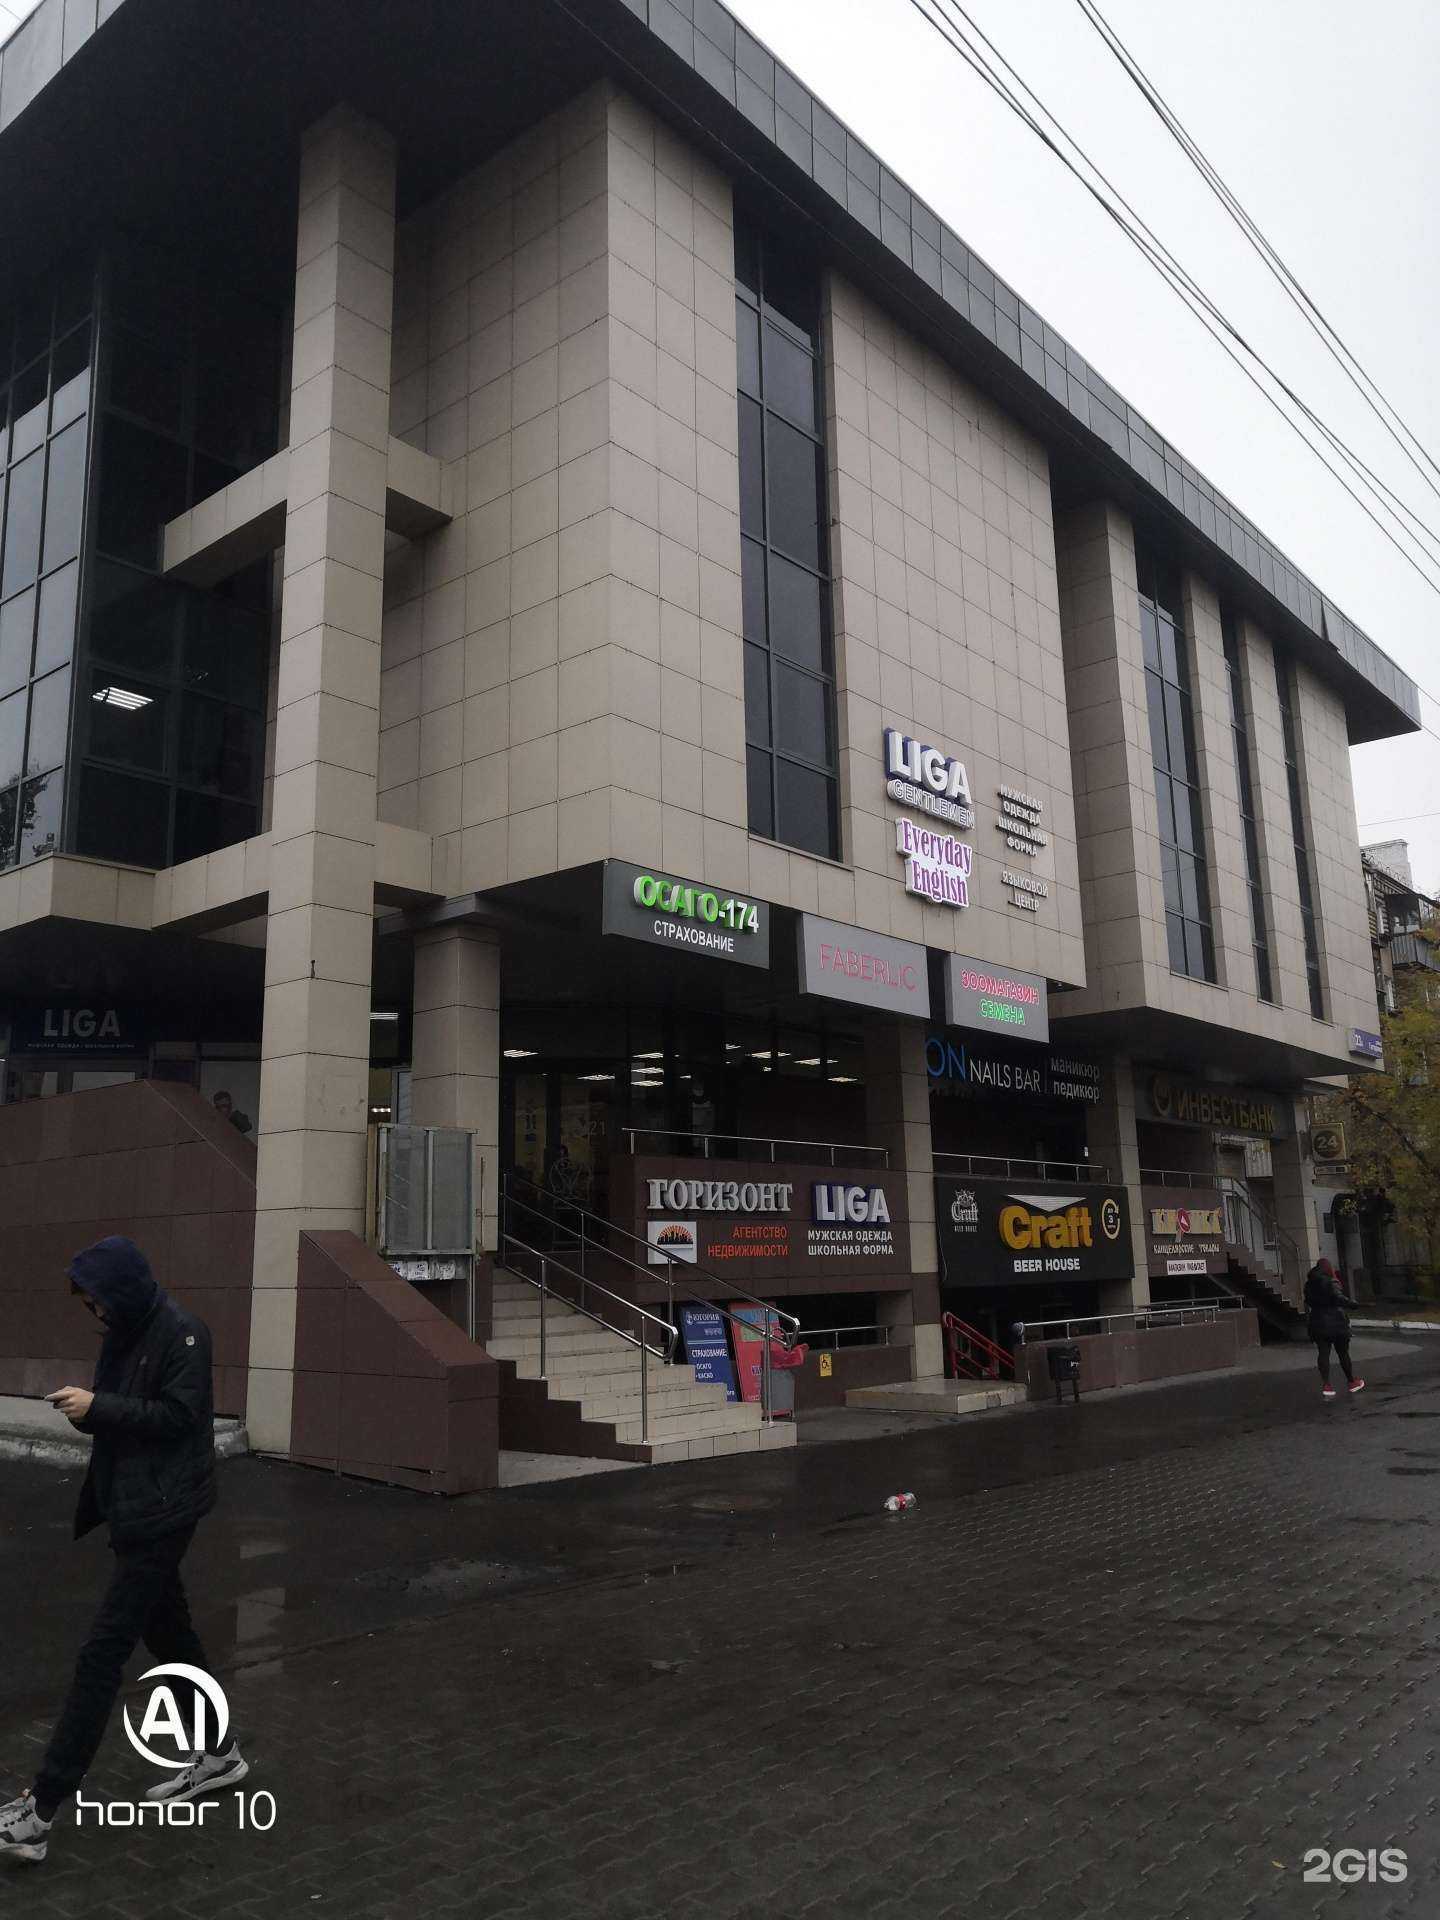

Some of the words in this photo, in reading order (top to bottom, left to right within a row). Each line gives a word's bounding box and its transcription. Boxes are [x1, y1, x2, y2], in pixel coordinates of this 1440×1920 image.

[885, 728, 972, 805] LIGA
[888, 779, 976, 830] GENTLEMEN
[998, 783, 1043, 813] МУЖСКАЯ
[1003, 801, 1042, 826] ОДЕЖДА
[998, 815, 1049, 847] ШКОЛЬНАЯ
[901, 819, 973, 875] Everyday
[1007, 836, 1038, 857] ФОРМА
[912, 860, 968, 908] English
[1001, 870, 1049, 898] ЯЗЫКОВОЙ
[634, 875, 760, 934] ОСАГО-174
[1013, 890, 1041, 912] ЦЕНТР
[653, 919, 734, 953] СТРАХОВАНИЕ
[819, 943, 917, 993] FABERLIC
[960, 967, 1041, 1006] ЗООМАГАЗИН
[43, 1008, 121, 1037] LIGA
[979, 998, 1026, 1026] СЕМЕНА
[968, 1058, 1012, 1089] NAILS
[1014, 1066, 1041, 1093] BAR
[1051, 1056, 1101, 1083] маникюр
[1052, 1078, 1101, 1104] педикюр
[1175, 1088, 1276, 1133] ИНВЕСТБАНК
[1316, 1135, 1339, 1149] 24
[646, 1178, 793, 1212] ГОРИЗОНТ
[812, 1182, 891, 1224] LIGA
[951, 1200, 979, 1223] Craft
[732, 1226, 788, 1239] АГЕНТСТВО
[808, 1230, 853, 1241] МУЖСКАЯ
[855, 1231, 893, 1242] ОДЕЖДА
[998, 1205, 1093, 1250] Craft
[707, 1244, 789, 1258] НЕДВИЖИМОСТИ
[808, 1245, 860, 1256] ШКОЛЬНАЯ
[862, 1244, 894, 1256] ФОРМА
[1013, 1260, 1043, 1273] BEER
[1045, 1258, 1081, 1271] HOUSE
